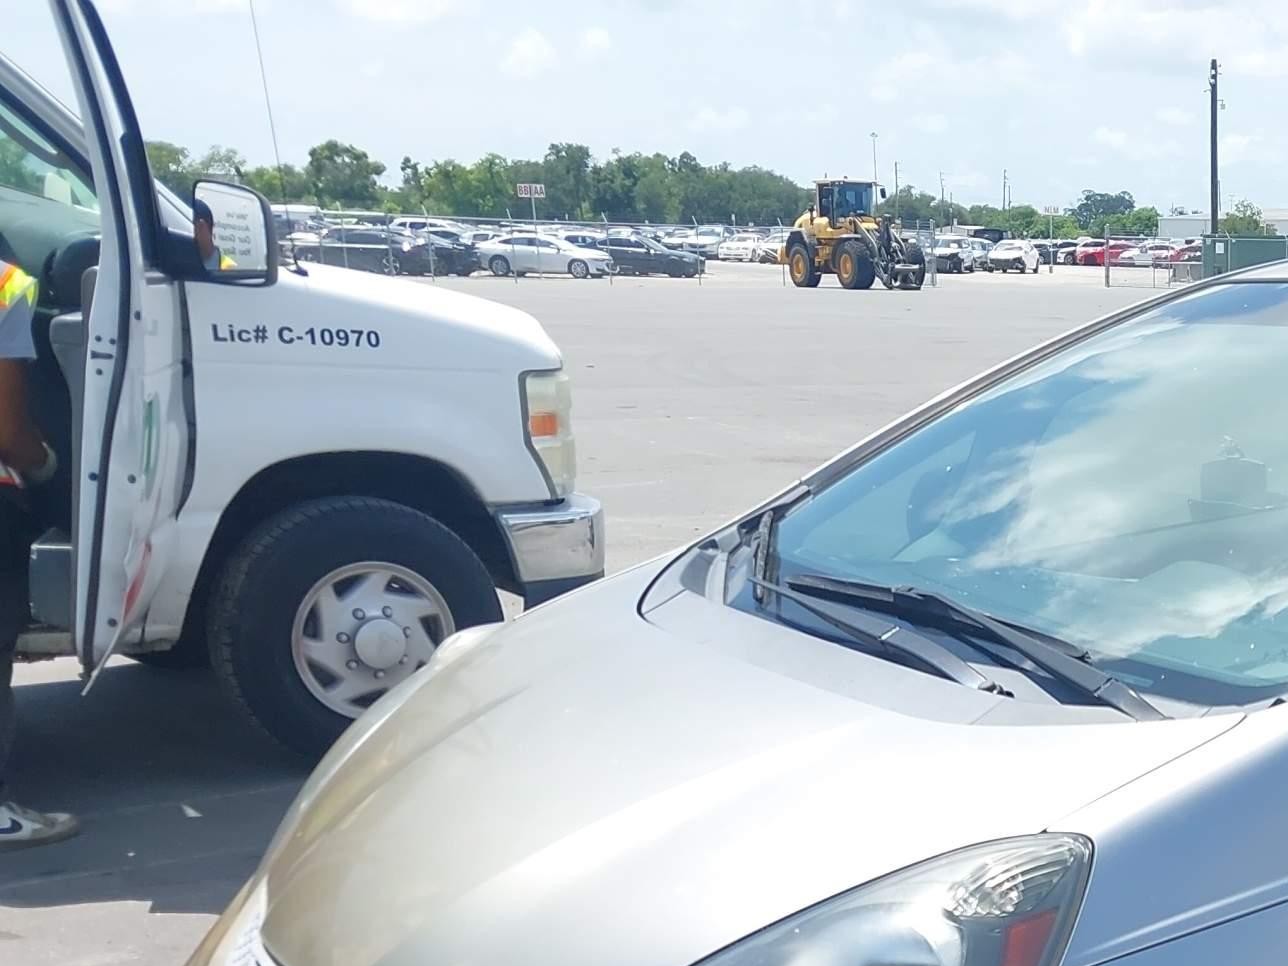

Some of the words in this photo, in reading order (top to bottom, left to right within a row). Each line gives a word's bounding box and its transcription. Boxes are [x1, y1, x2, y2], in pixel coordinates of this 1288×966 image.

[534, 185, 545, 197] AA
[211, 323, 268, 343] Lic#
[277, 326, 381, 348] C-10970
